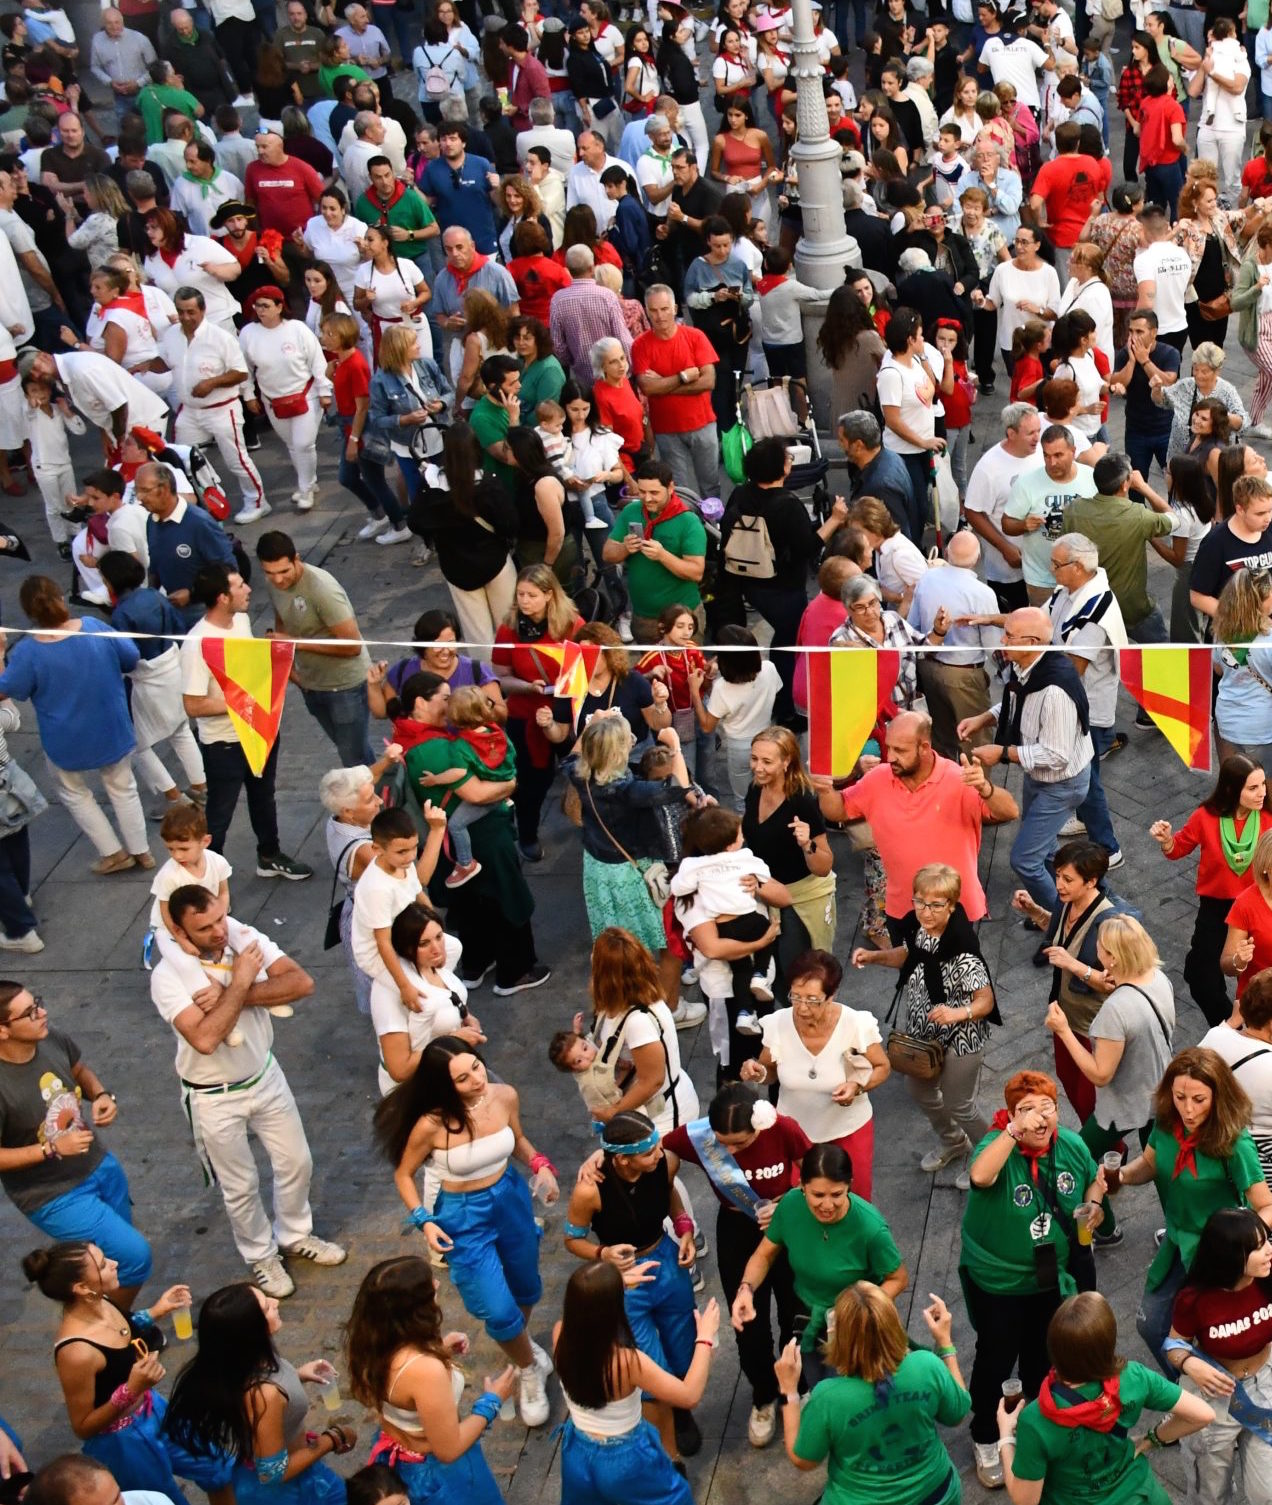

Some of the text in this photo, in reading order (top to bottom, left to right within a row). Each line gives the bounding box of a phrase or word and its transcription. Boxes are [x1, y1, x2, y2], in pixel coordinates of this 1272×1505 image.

[1243, 555, 1259, 571] TOP
[755, 1162, 785, 1180] 2023
[1208, 1316, 1251, 1339] DAMAS
